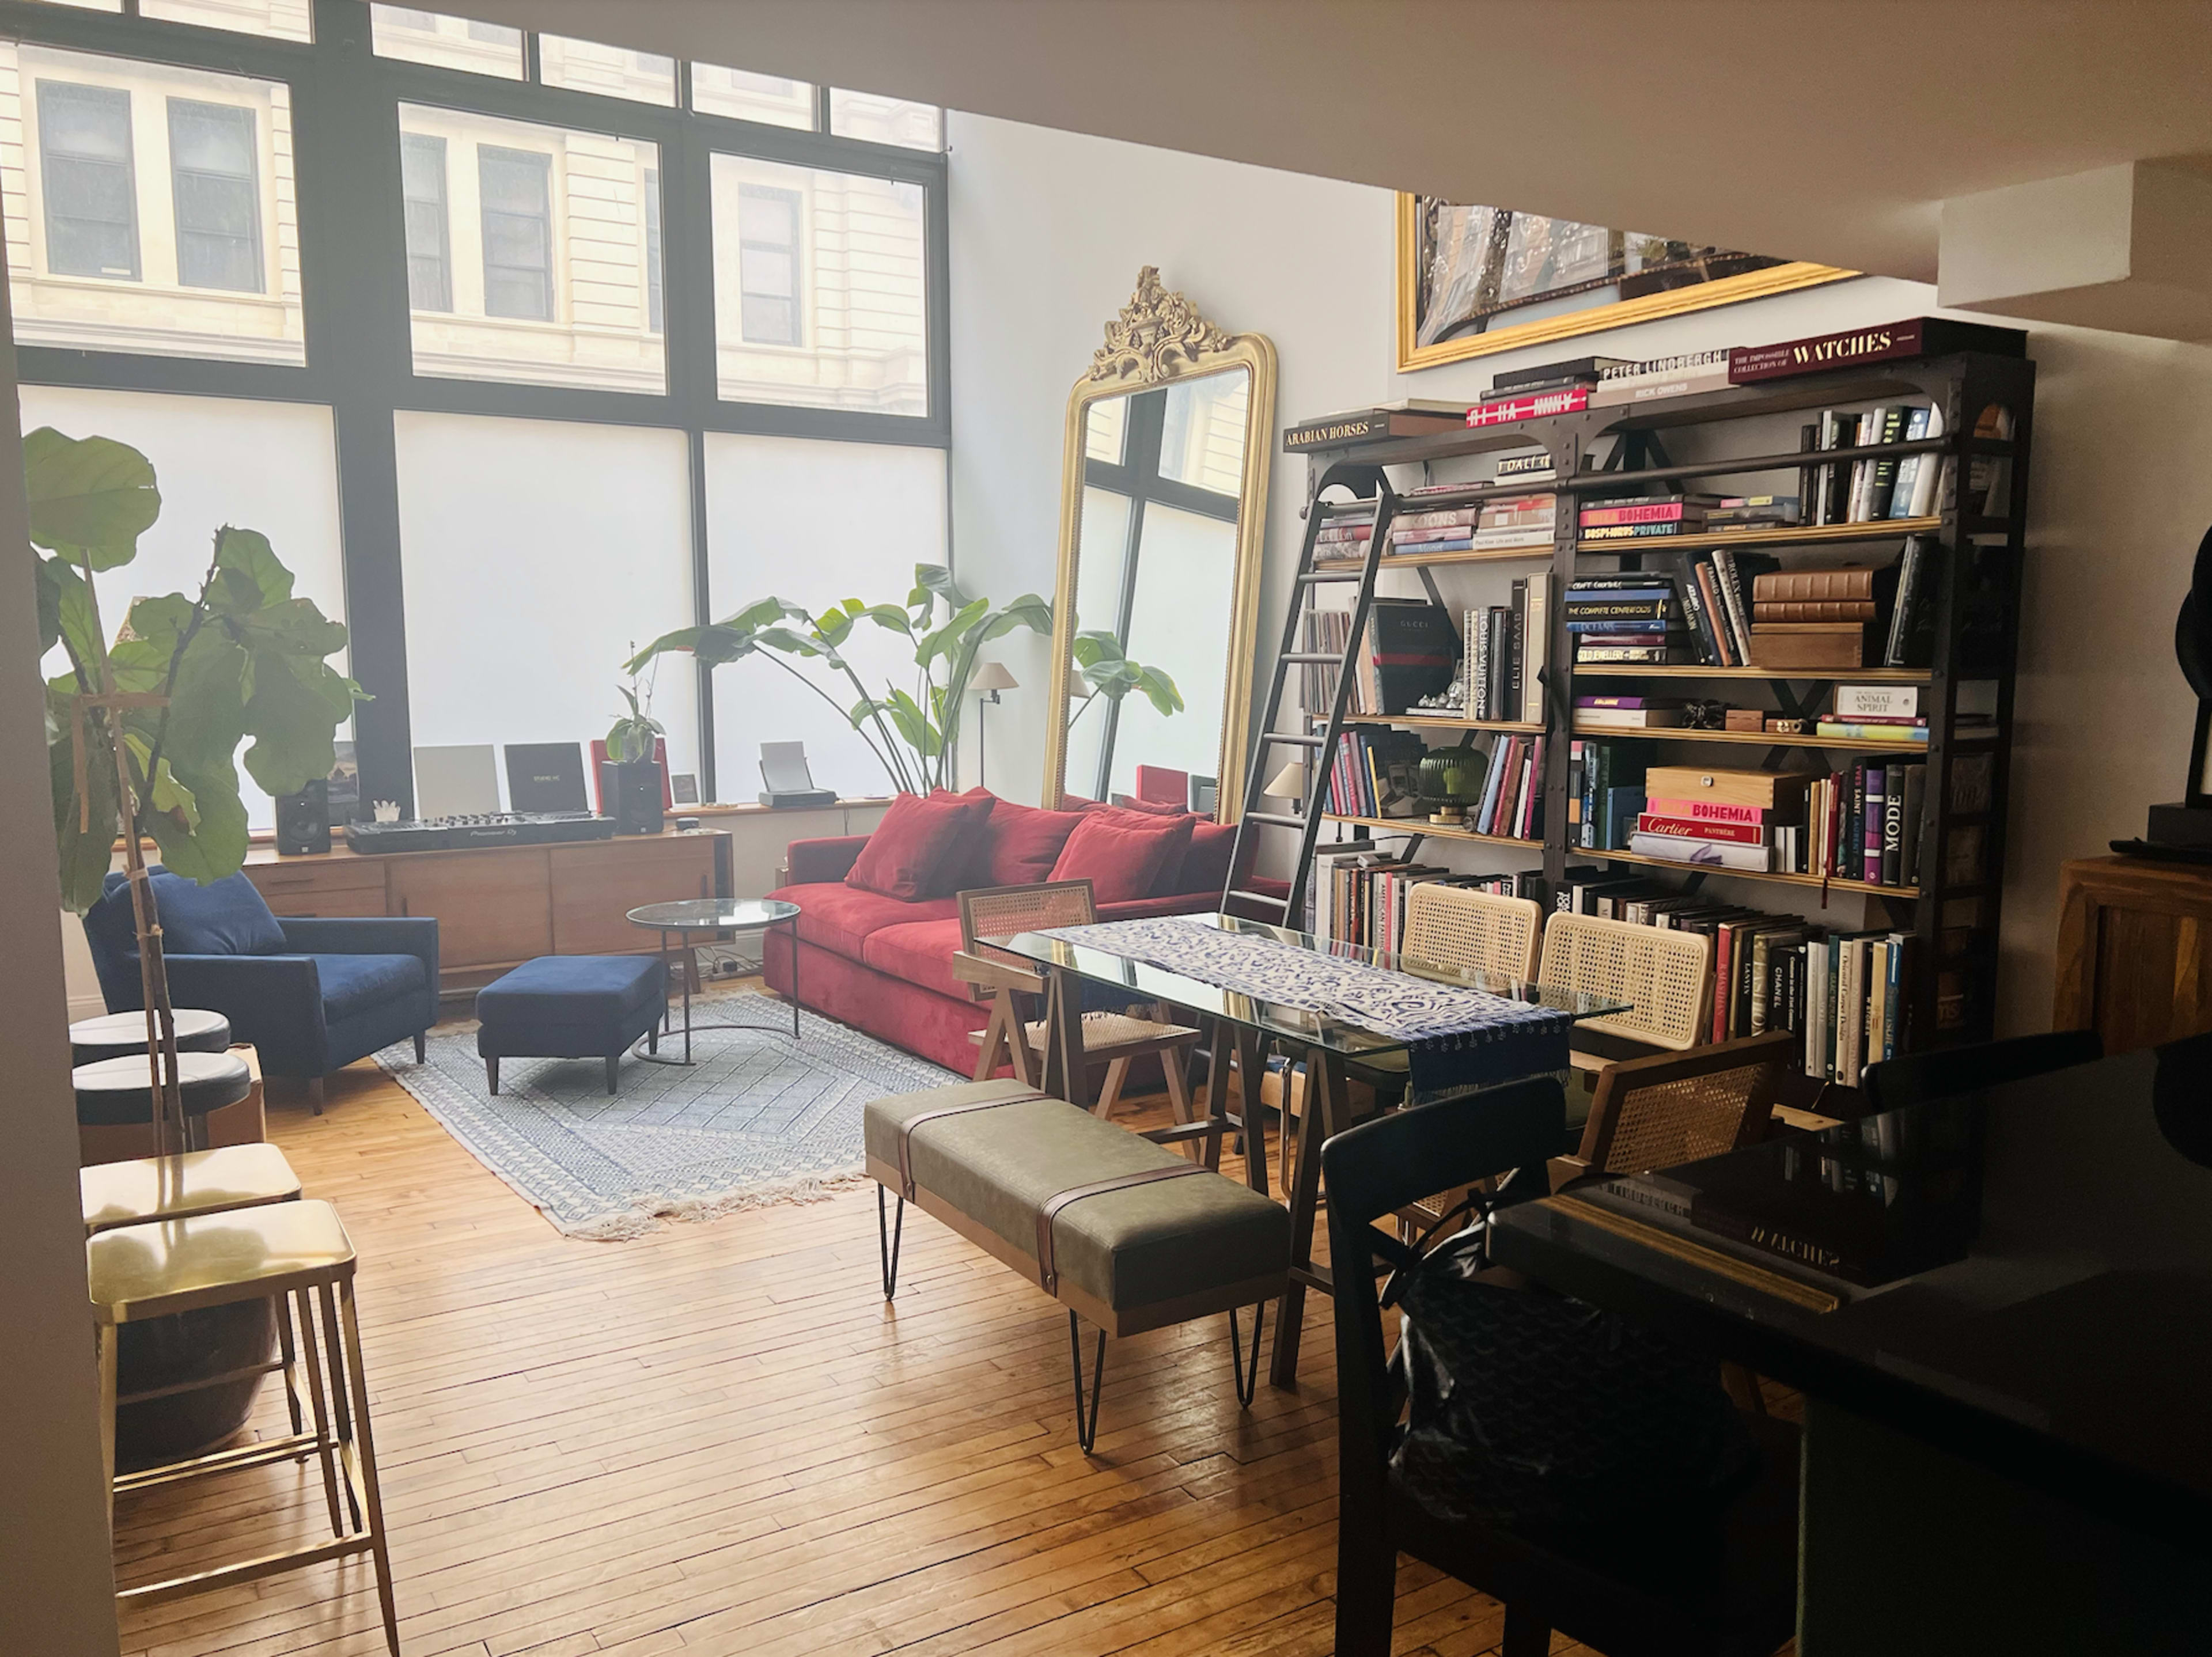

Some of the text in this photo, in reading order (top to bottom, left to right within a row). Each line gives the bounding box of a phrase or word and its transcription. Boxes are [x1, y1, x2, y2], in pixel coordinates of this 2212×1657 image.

[1793, 331, 1892, 365] WATCHES
[1603, 350, 1722, 381] PETER LINDBERGH
[1635, 382, 1688, 399] RICK OWENS
[1285, 420, 1369, 446] ARABIAN HORSES
[1619, 506, 1673, 522] BOHEMIA
[1634, 523, 1673, 536] PRIVATE
[1728, 559, 1741, 594] ROLEX
[1400, 620, 1429, 628] GUCCI
[1476, 615, 1489, 710] LOUIS VUITTON
[1512, 612, 1522, 691] ELIE SAAB
[1854, 695, 1893, 704] ANIMAL
[1857, 704, 1889, 712] SPIRIT
[1854, 764, 1862, 787] YVES
[1692, 804, 1753, 822] BOHEMIA
[1853, 788, 1862, 816] SAINT
[1647, 817, 1692, 836] Cartier
[1885, 795, 1901, 852] MODE
[1773, 966, 1783, 1008] CHANEL
[1839, 955, 1850, 1041] Oriental Carpet Design
